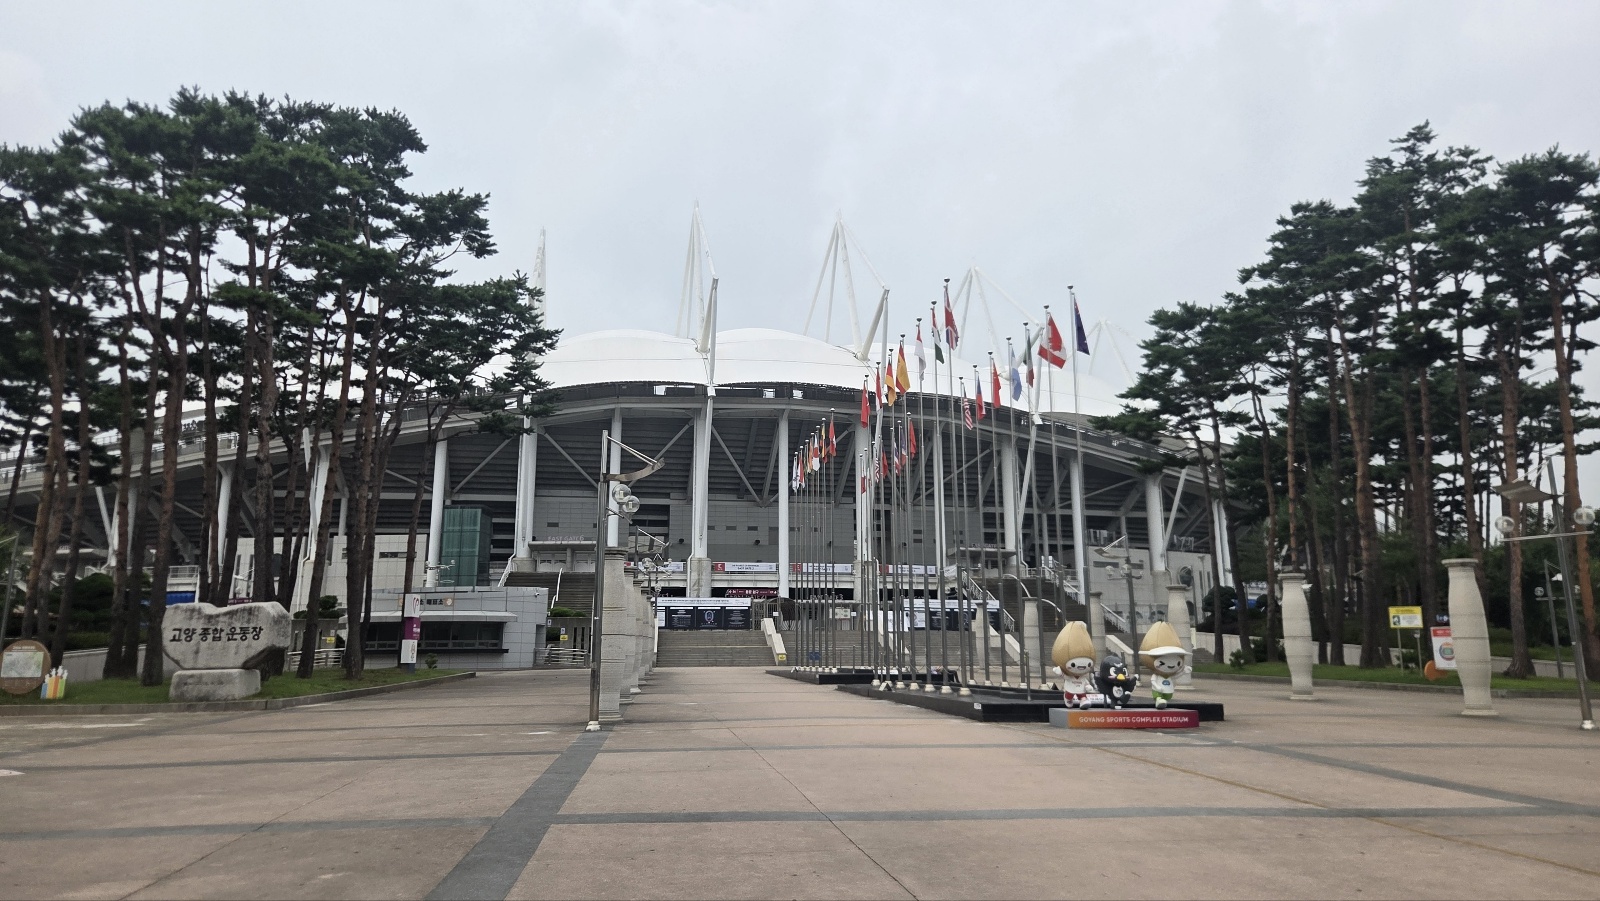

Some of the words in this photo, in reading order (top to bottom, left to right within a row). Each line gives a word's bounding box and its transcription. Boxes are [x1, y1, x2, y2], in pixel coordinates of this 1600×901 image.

[169, 627, 197, 642] 고양
[199, 626, 224, 642] 종합
[226, 625, 264, 642] 운동장
